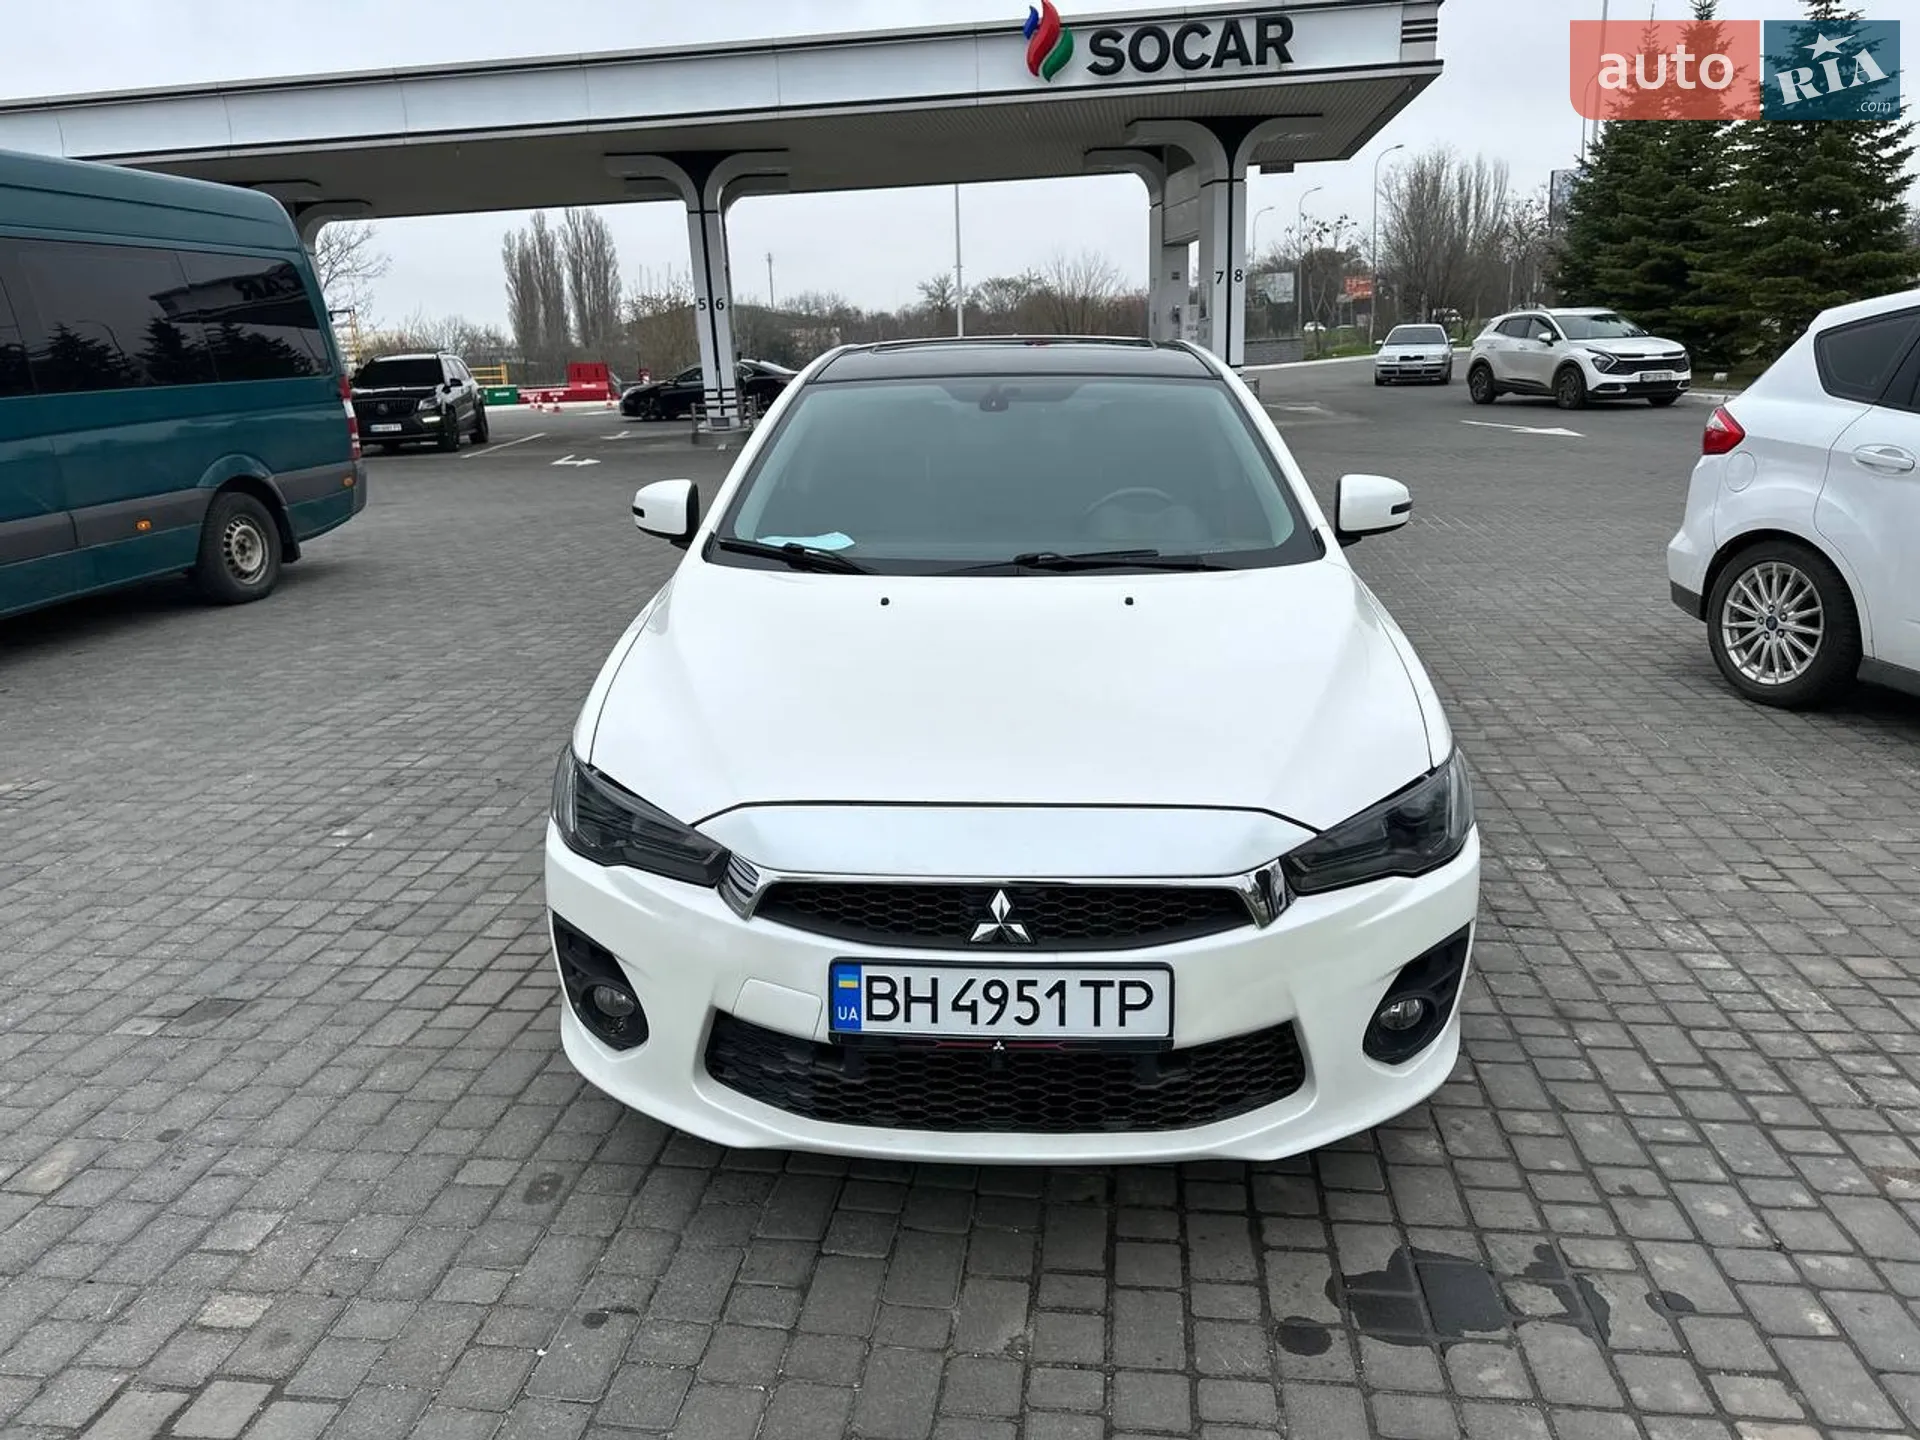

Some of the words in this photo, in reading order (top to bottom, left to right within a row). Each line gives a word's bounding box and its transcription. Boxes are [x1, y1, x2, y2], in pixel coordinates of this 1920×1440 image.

[1087, 15, 1294, 76] SOCAR
[1215, 270, 1225, 285] 7
[1234, 268, 1244, 283] 8
[698, 297, 706, 311] 5
[715, 297, 725, 311] 6
[865, 975, 939, 1024] BH
[951, 978, 1067, 1027] 4951
[1079, 979, 1154, 1028] TP
[837, 1006, 859, 1021] UA
